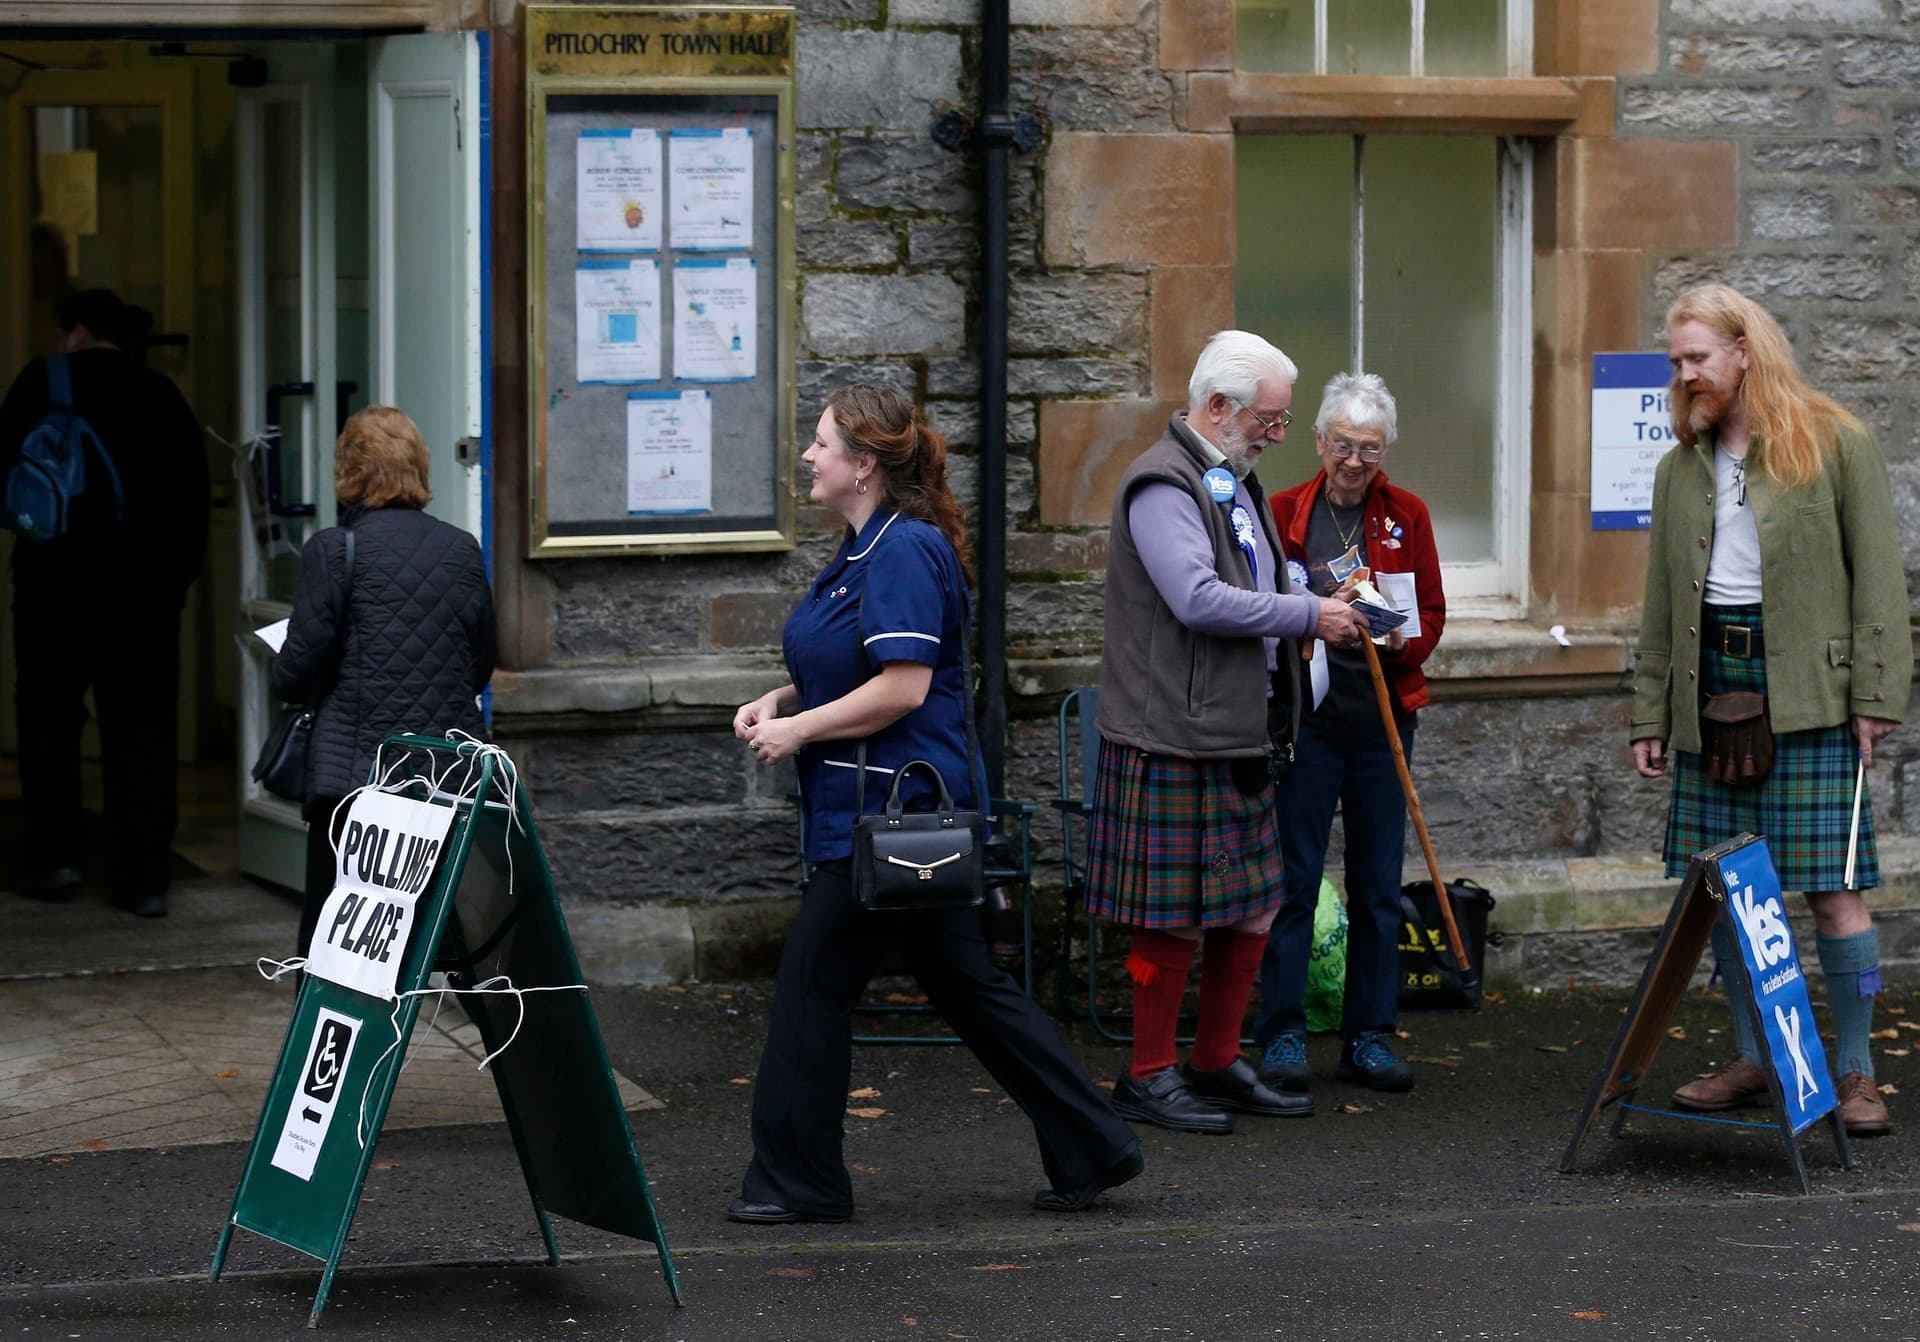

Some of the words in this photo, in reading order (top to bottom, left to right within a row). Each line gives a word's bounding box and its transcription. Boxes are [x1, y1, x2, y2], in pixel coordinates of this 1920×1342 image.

[545, 33, 649, 54] PITLOCHRY
[661, 33, 721, 54] TOWN
[729, 33, 776, 54] HALL
[1207, 475, 1234, 492] Yes
[343, 820, 439, 894] POLLING
[1724, 869, 1740, 888] Vote
[327, 892, 404, 963] PLACE
[1731, 884, 1791, 972] Yes
